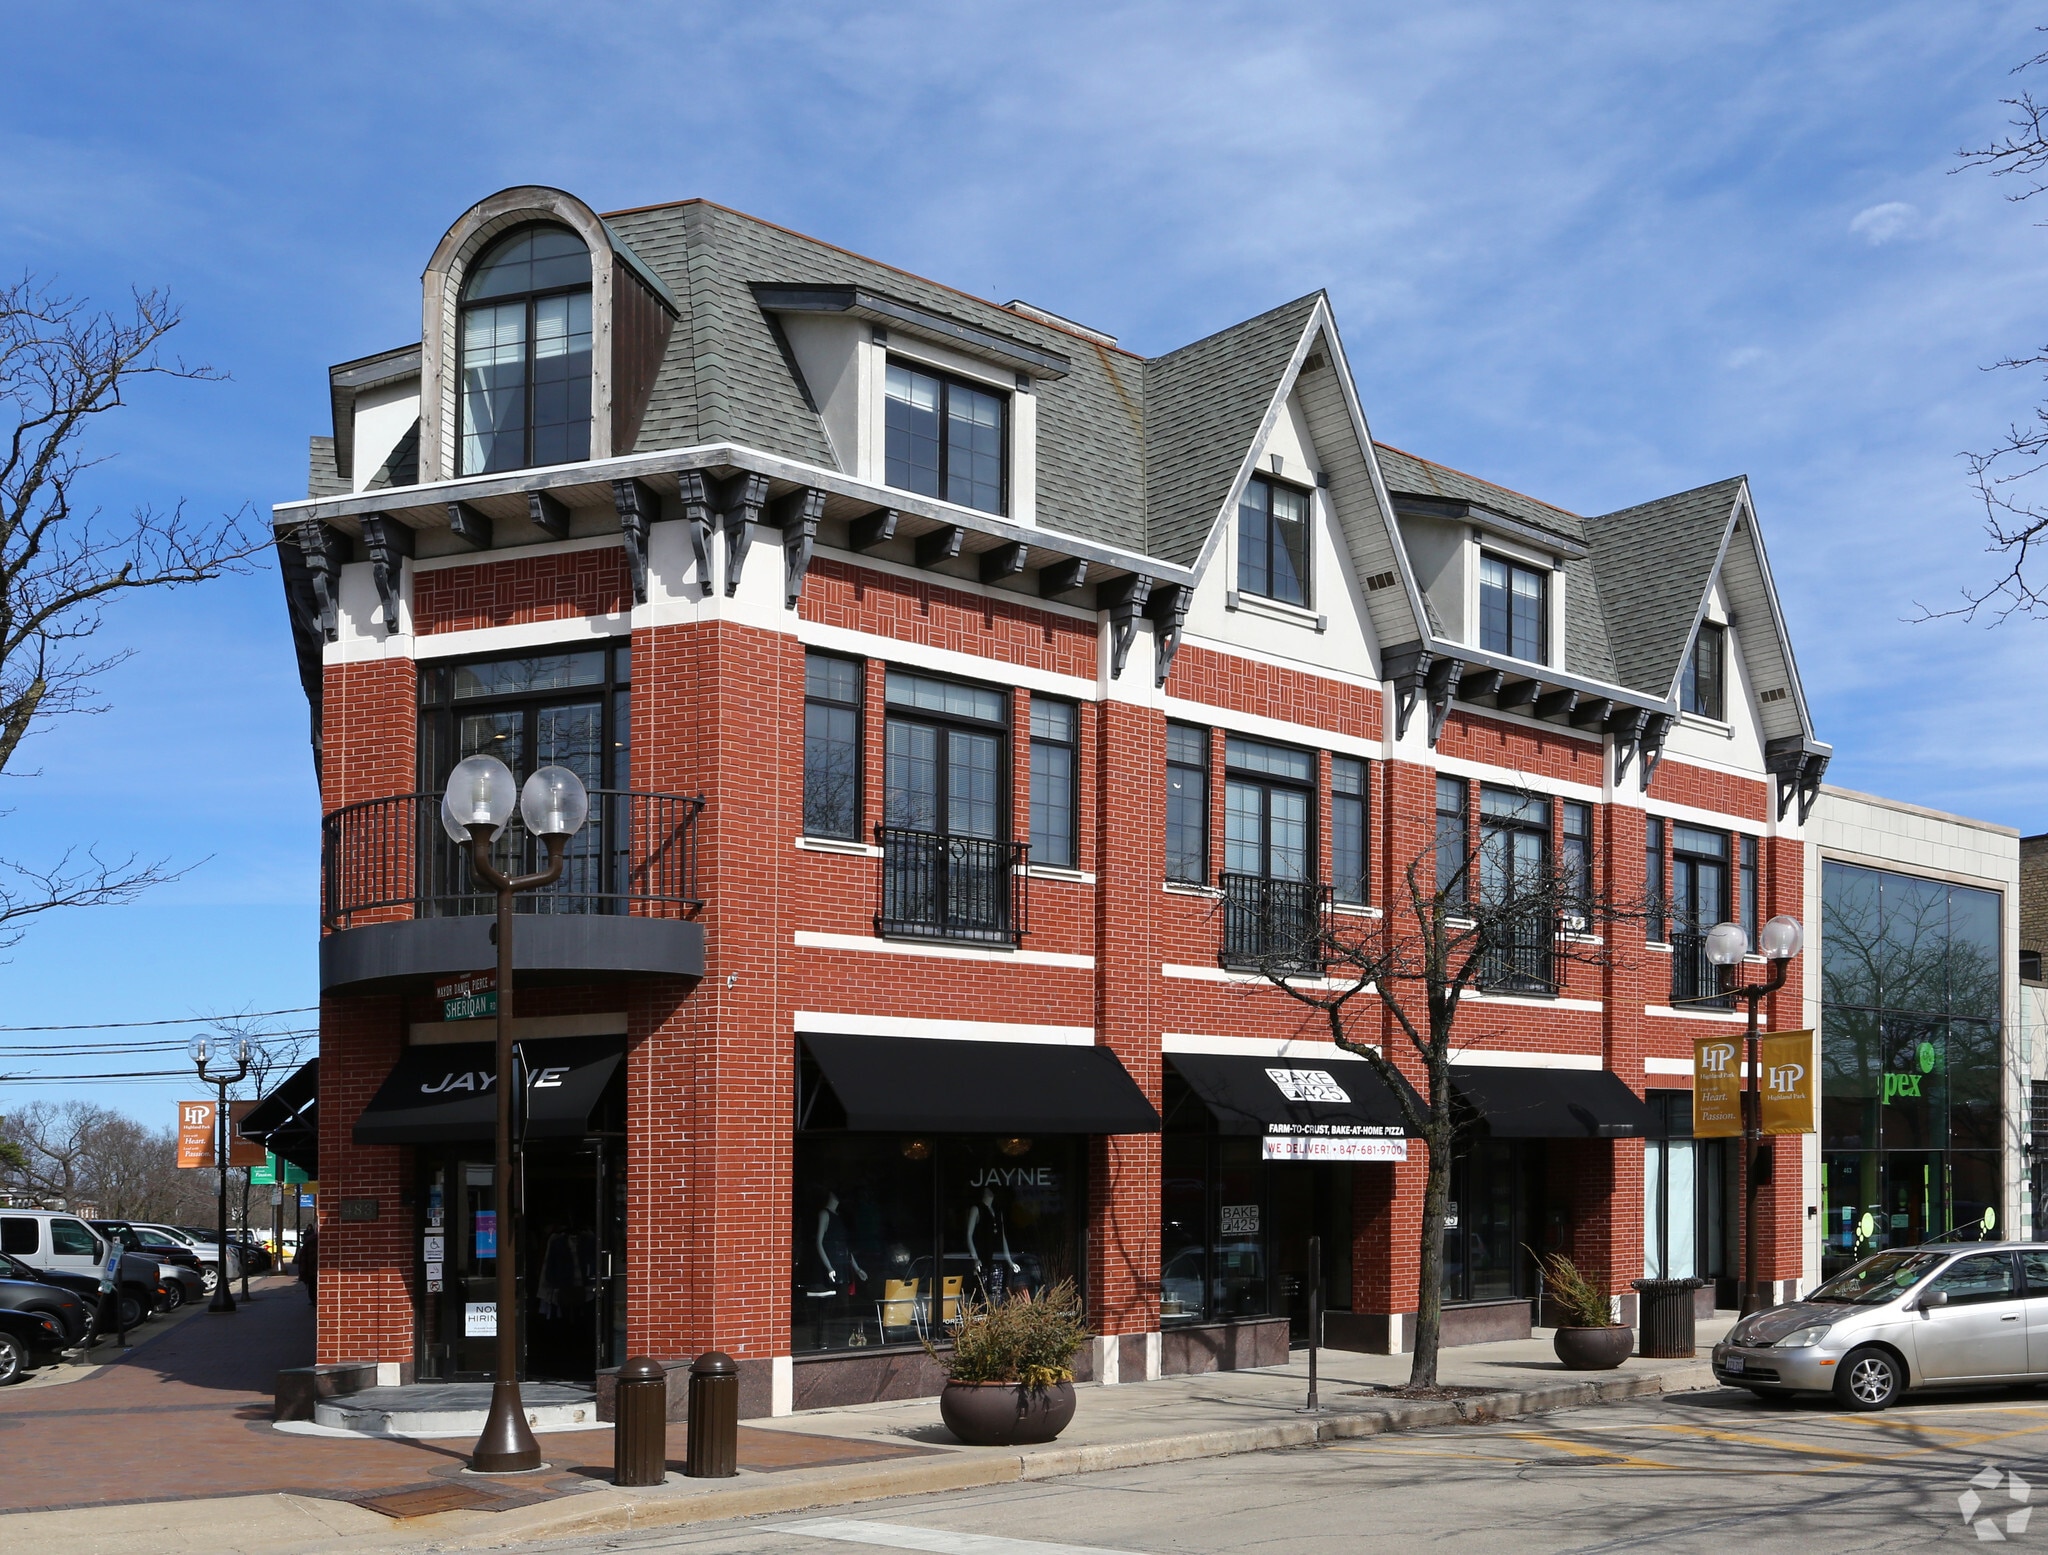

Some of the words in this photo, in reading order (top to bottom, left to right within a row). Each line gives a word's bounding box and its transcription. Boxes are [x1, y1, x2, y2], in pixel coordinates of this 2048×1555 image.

[437, 985, 453, 998] MAYOR
[454, 981, 470, 995] DANIEL
[472, 977, 488, 991] PIERCE
[446, 997, 486, 1018] SHERIDAN
[1702, 1044, 1735, 1072] HP
[421, 1067, 570, 1093] JAYE
[1269, 1070, 1335, 1085] BAKE
[1700, 1072, 1722, 1080] Highland
[1723, 1071, 1735, 1079] Park
[1769, 1063, 1804, 1093] HP
[1702, 1092, 1728, 1101] Heart.
[184, 1105, 210, 1125] HP
[1703, 1111, 1736, 1121] Passion.
[1269, 1123, 1330, 1135] FARM-TO-CRUST,
[1331, 1125, 1383, 1135] BAKE-AT-HOME
[1384, 1126, 1405, 1136] PIZZA
[1268, 1143, 1282, 1154] WE
[1285, 1144, 1330, 1155] DELIVER!
[1339, 1145, 1403, 1156] 847-681-9700
[970, 1167, 1052, 1188] JAYNE
[1223, 1206, 1258, 1218] BAKE
